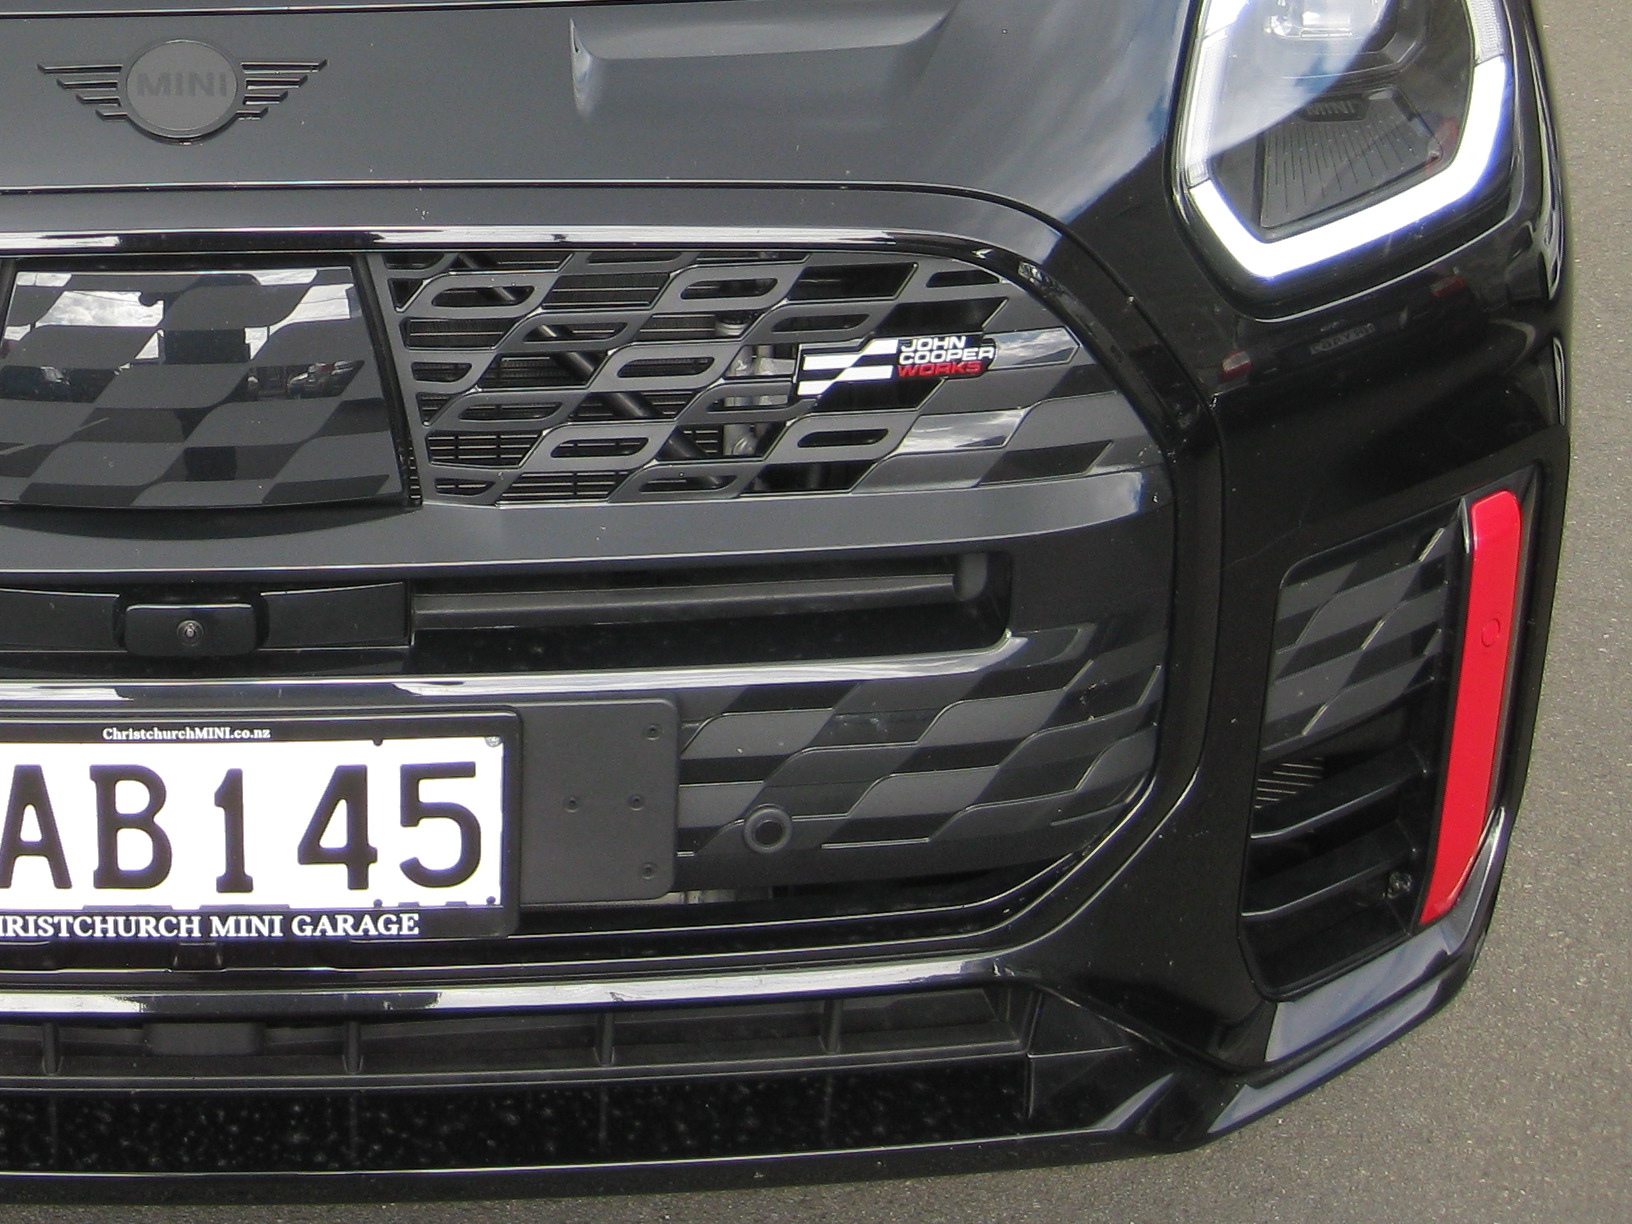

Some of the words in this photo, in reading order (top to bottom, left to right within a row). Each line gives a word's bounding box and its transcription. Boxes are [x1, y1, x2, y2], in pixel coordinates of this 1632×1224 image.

[136, 72, 227, 97] MINI
[901, 336, 966, 352] JOHN
[899, 347, 995, 365] COOPER
[897, 360, 984, 377] WORKS
[102, 726, 271, 741] ChristchurchMINI.co.nz
[209, 914, 285, 938] MINI
[290, 913, 421, 938] GARAGE
